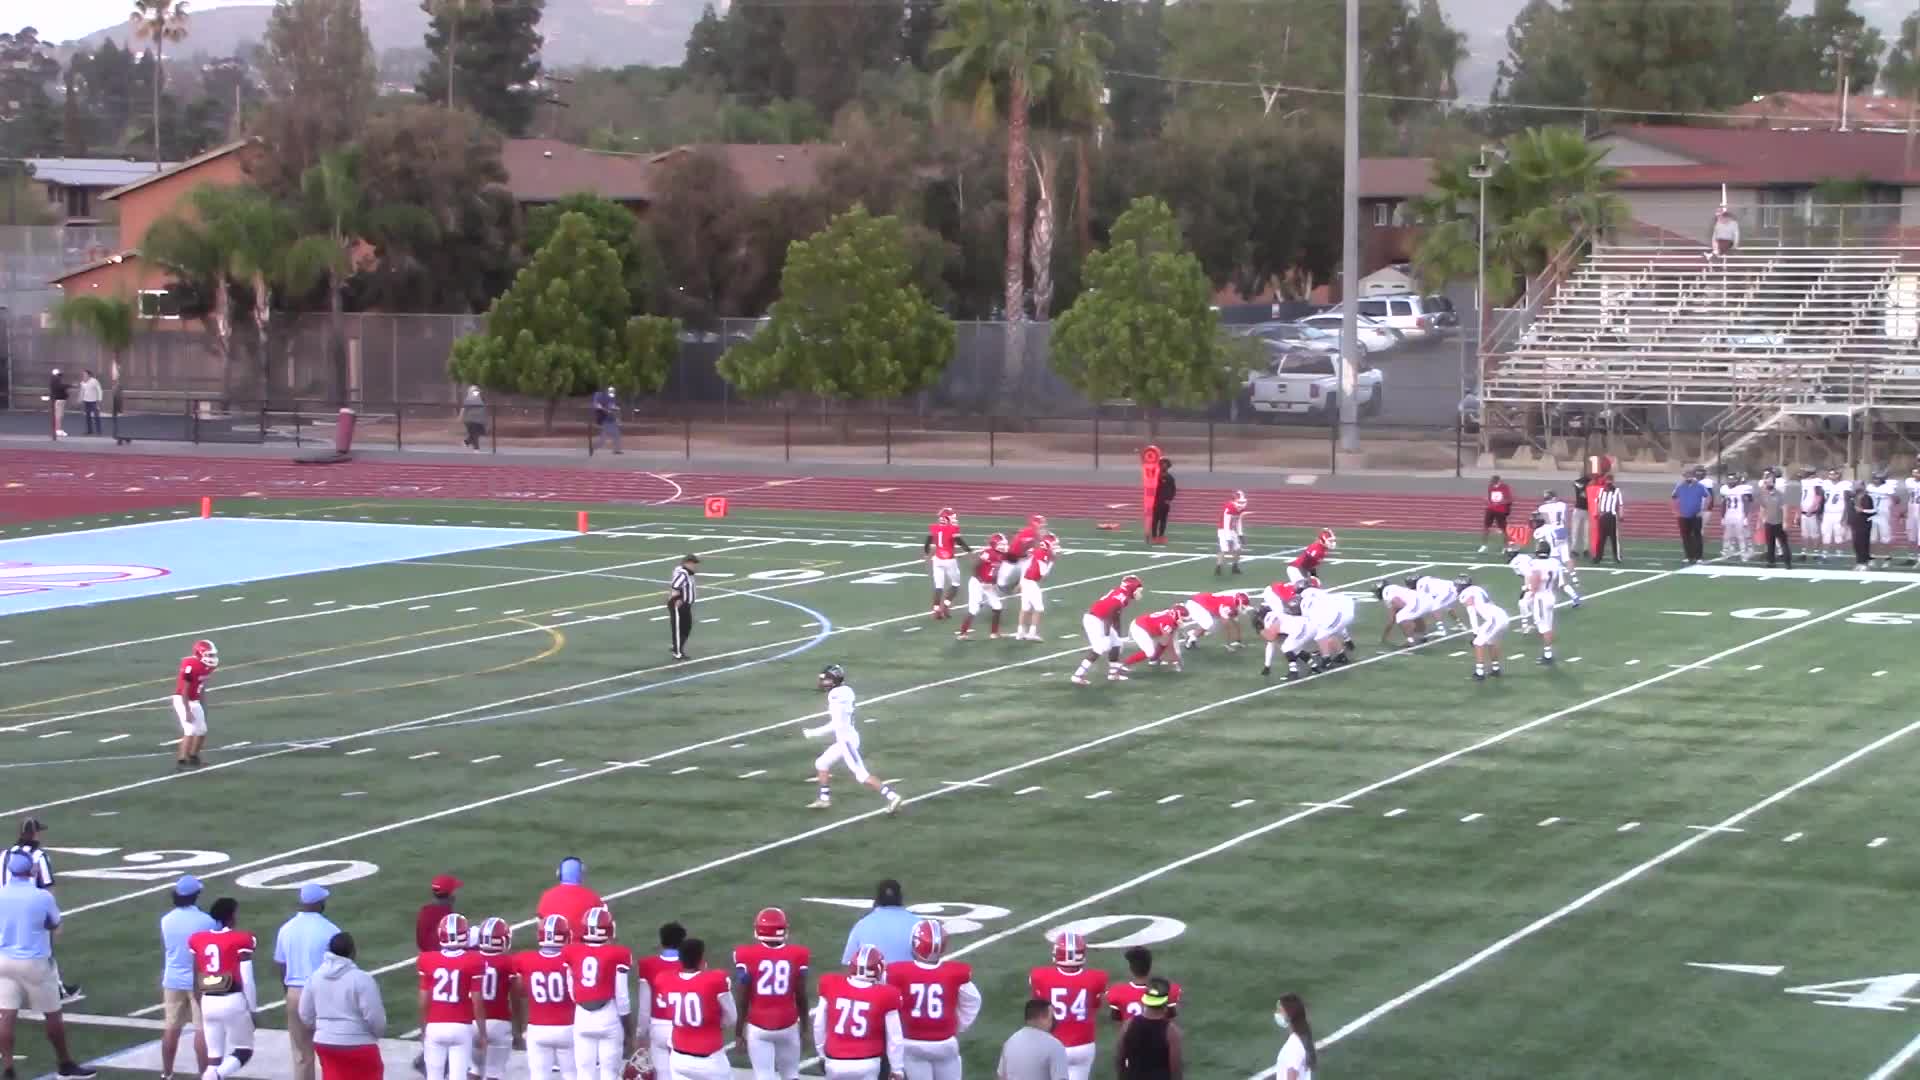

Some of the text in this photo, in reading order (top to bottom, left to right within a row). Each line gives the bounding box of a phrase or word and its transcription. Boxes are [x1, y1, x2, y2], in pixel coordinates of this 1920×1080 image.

[937, 531, 943, 548] 1
[204, 943, 221, 973] 3
[580, 956, 599, 988] 9
[432, 967, 460, 1003] 21
[530, 971, 564, 1003] 60
[756, 959, 791, 996] 28
[667, 991, 703, 1027] 70
[833, 997, 871, 1037] 75
[909, 983, 944, 1019] 76
[1050, 987, 1088, 1021] 54
